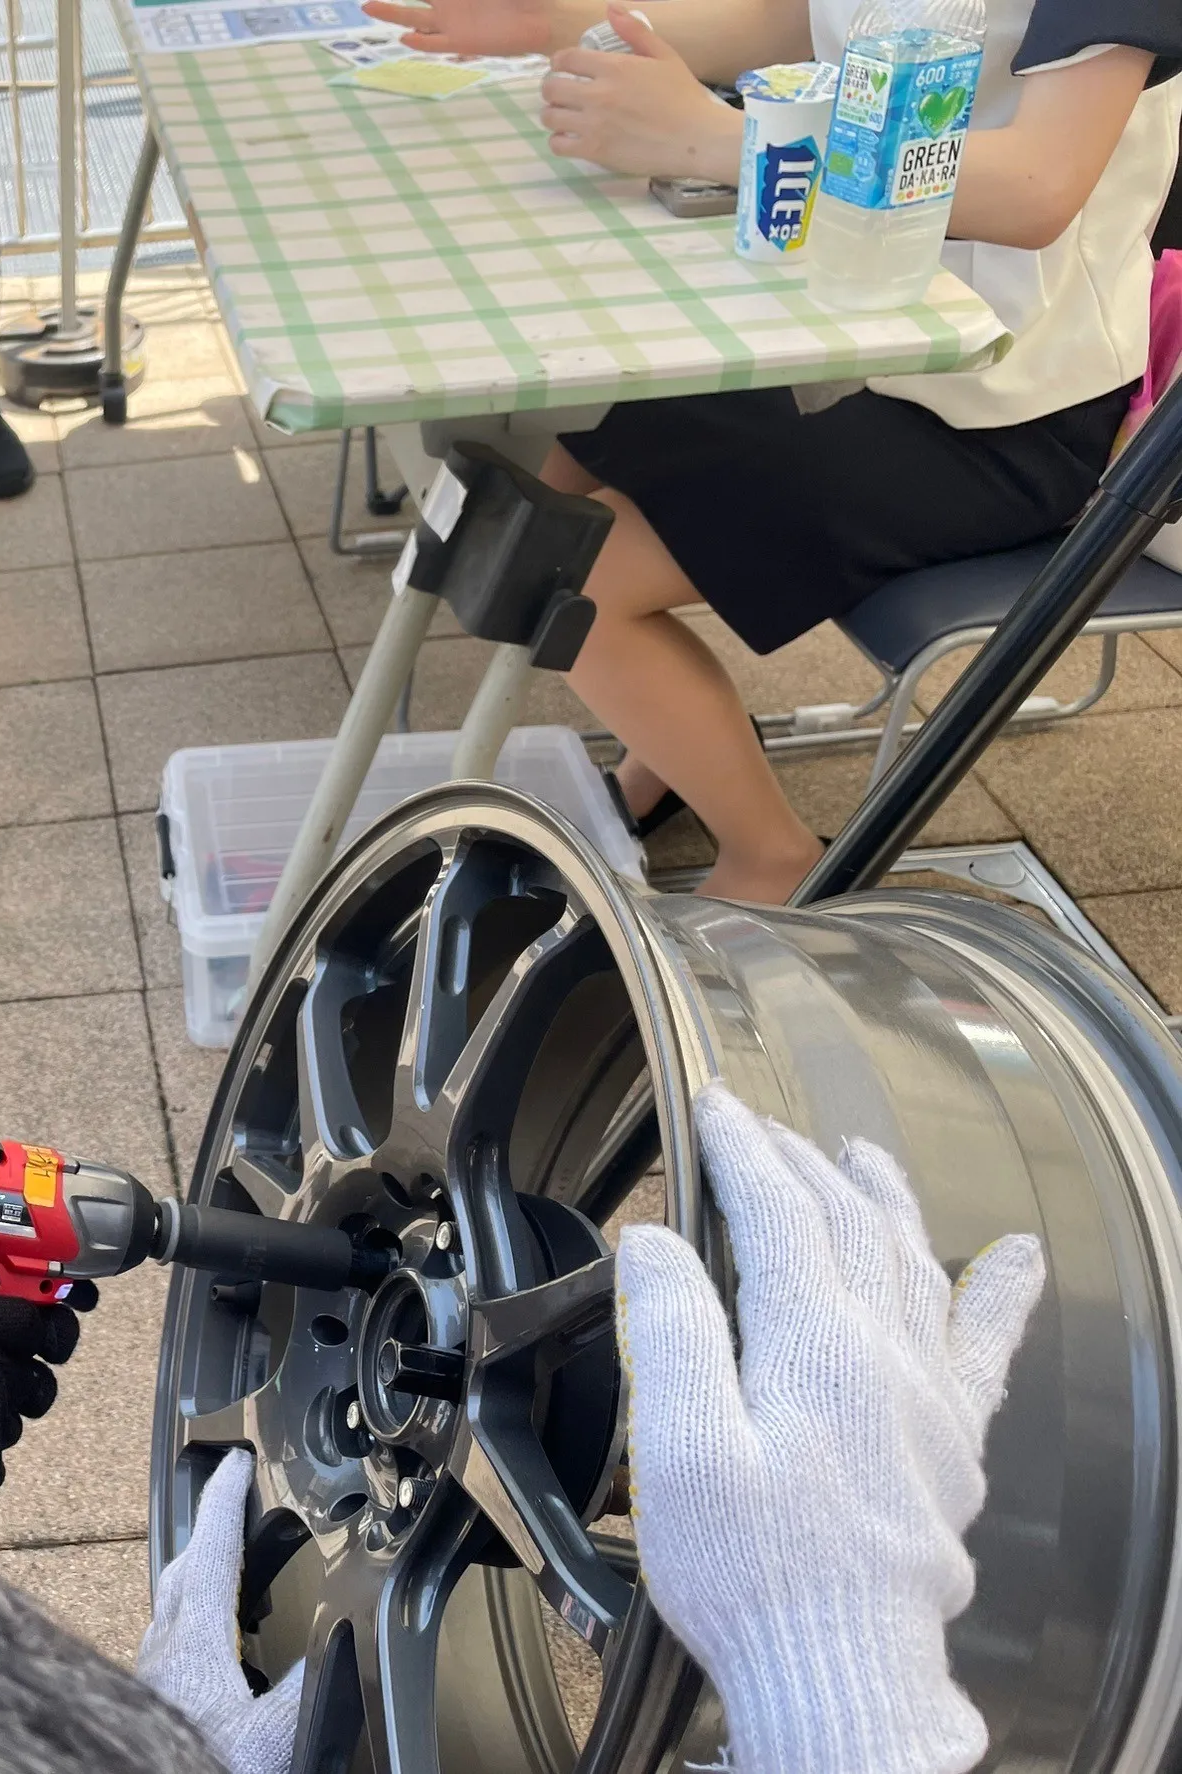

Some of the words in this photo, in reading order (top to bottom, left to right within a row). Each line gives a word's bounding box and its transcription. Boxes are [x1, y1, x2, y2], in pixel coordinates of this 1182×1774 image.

[915, 65, 945, 87] 600
[902, 139, 962, 172] GREEN
[771, 159, 815, 219] ICE
[769, 223, 802, 240] BOX
